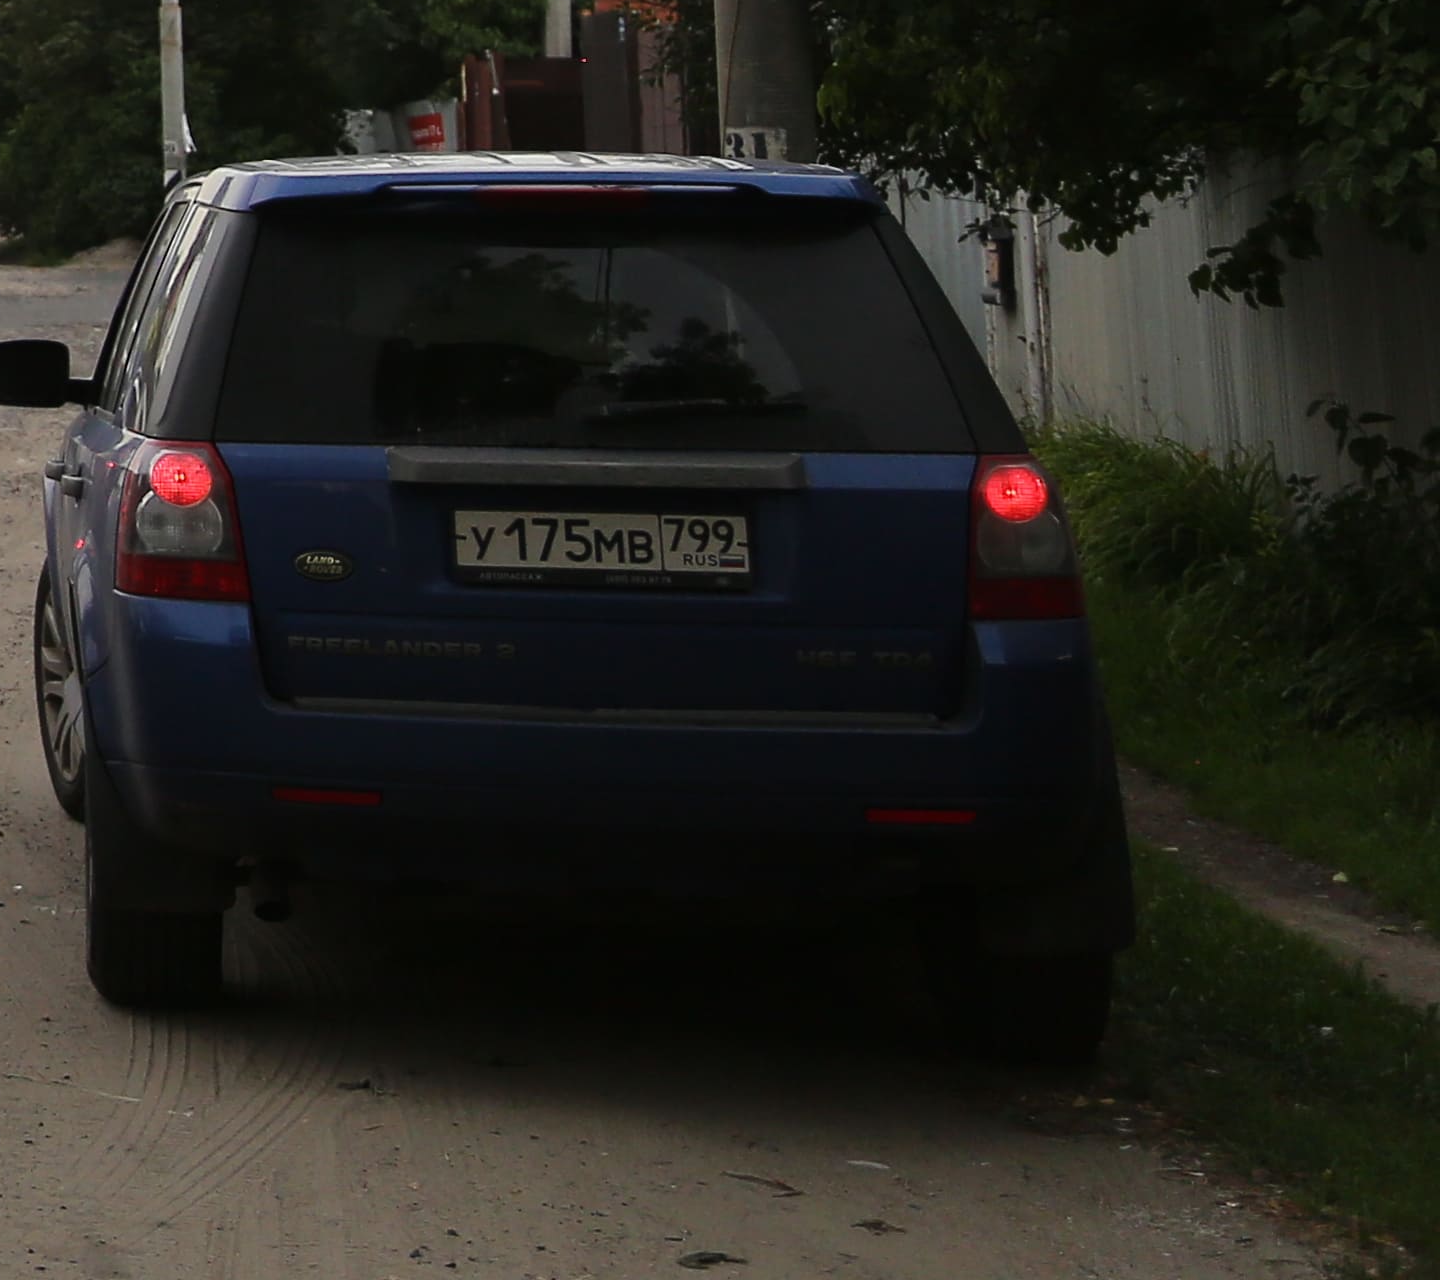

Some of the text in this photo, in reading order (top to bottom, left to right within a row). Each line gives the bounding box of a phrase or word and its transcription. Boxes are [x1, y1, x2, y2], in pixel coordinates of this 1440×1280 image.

[663, 518, 735, 554] 799
[683, 552, 719, 568] RUS
[287, 635, 516, 659] FREELANDER 2
